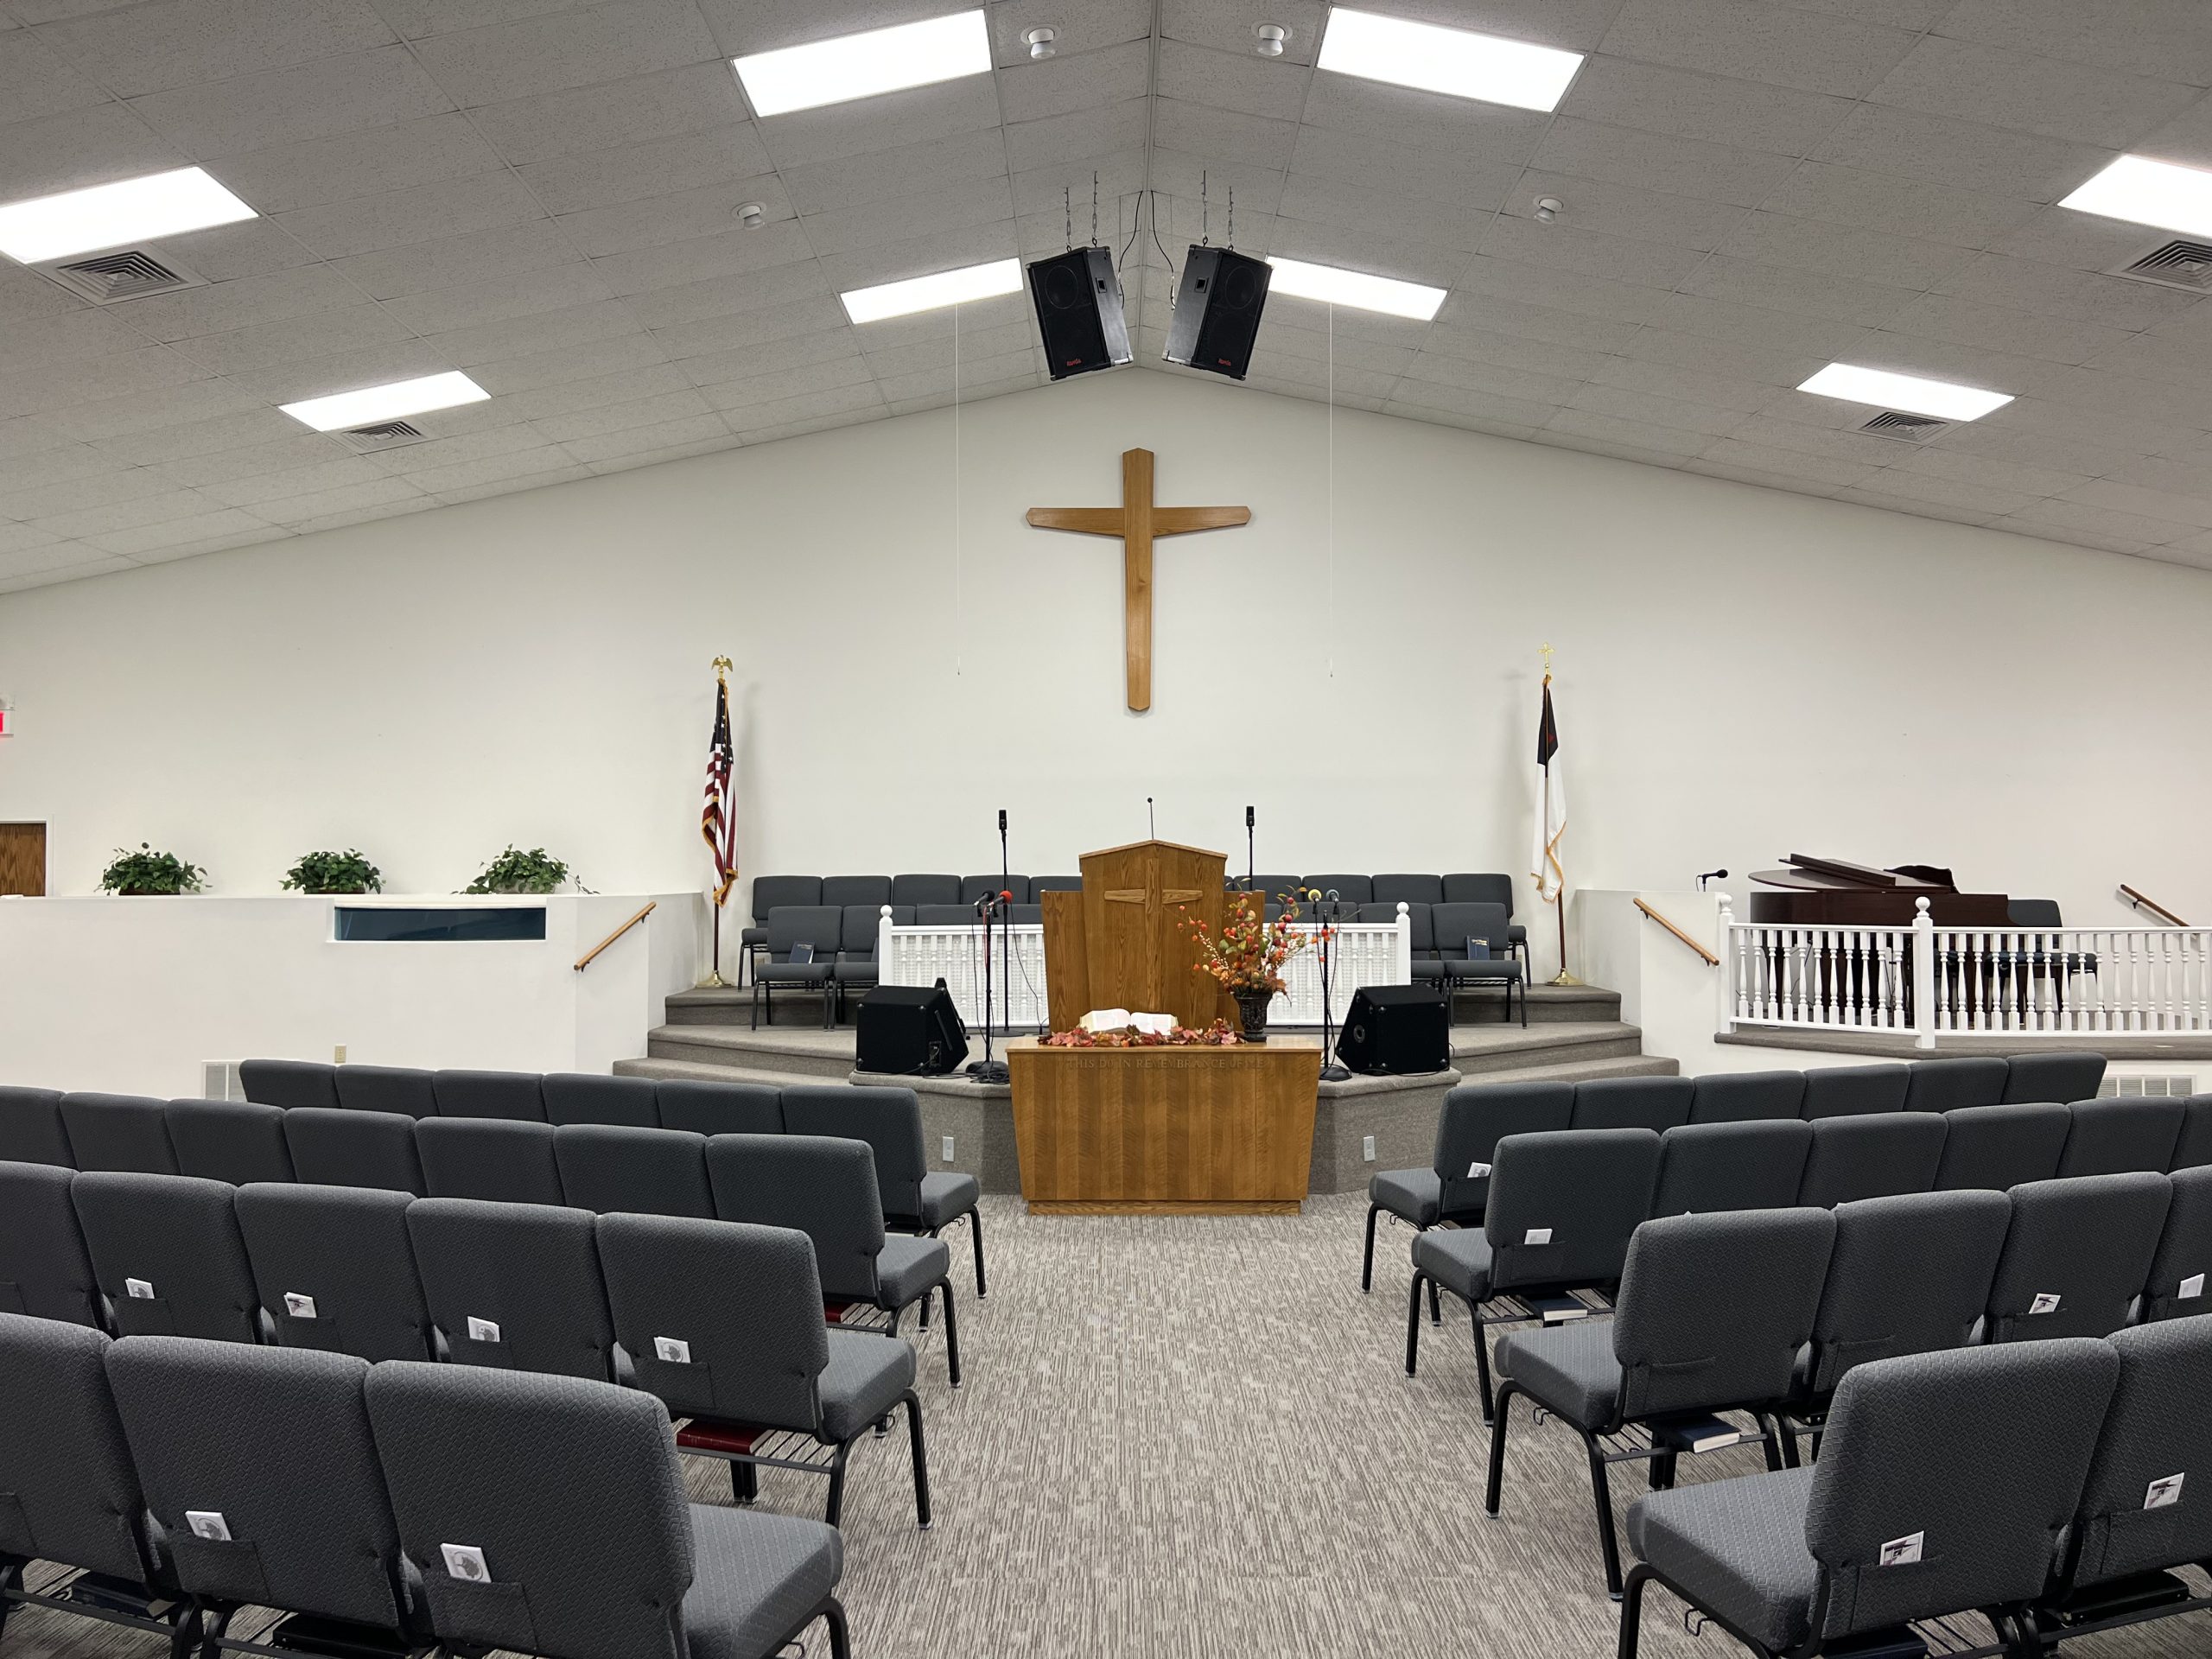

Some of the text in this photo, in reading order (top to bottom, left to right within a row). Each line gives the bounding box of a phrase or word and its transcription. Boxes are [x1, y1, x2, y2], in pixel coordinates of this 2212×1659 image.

[1067, 1058, 1095, 1069] THIS
[1099, 1058, 1115, 1069] DO
[1118, 1058, 1132, 1069] IN
[1135, 1058, 1227, 1069] REMEMBRANCE
